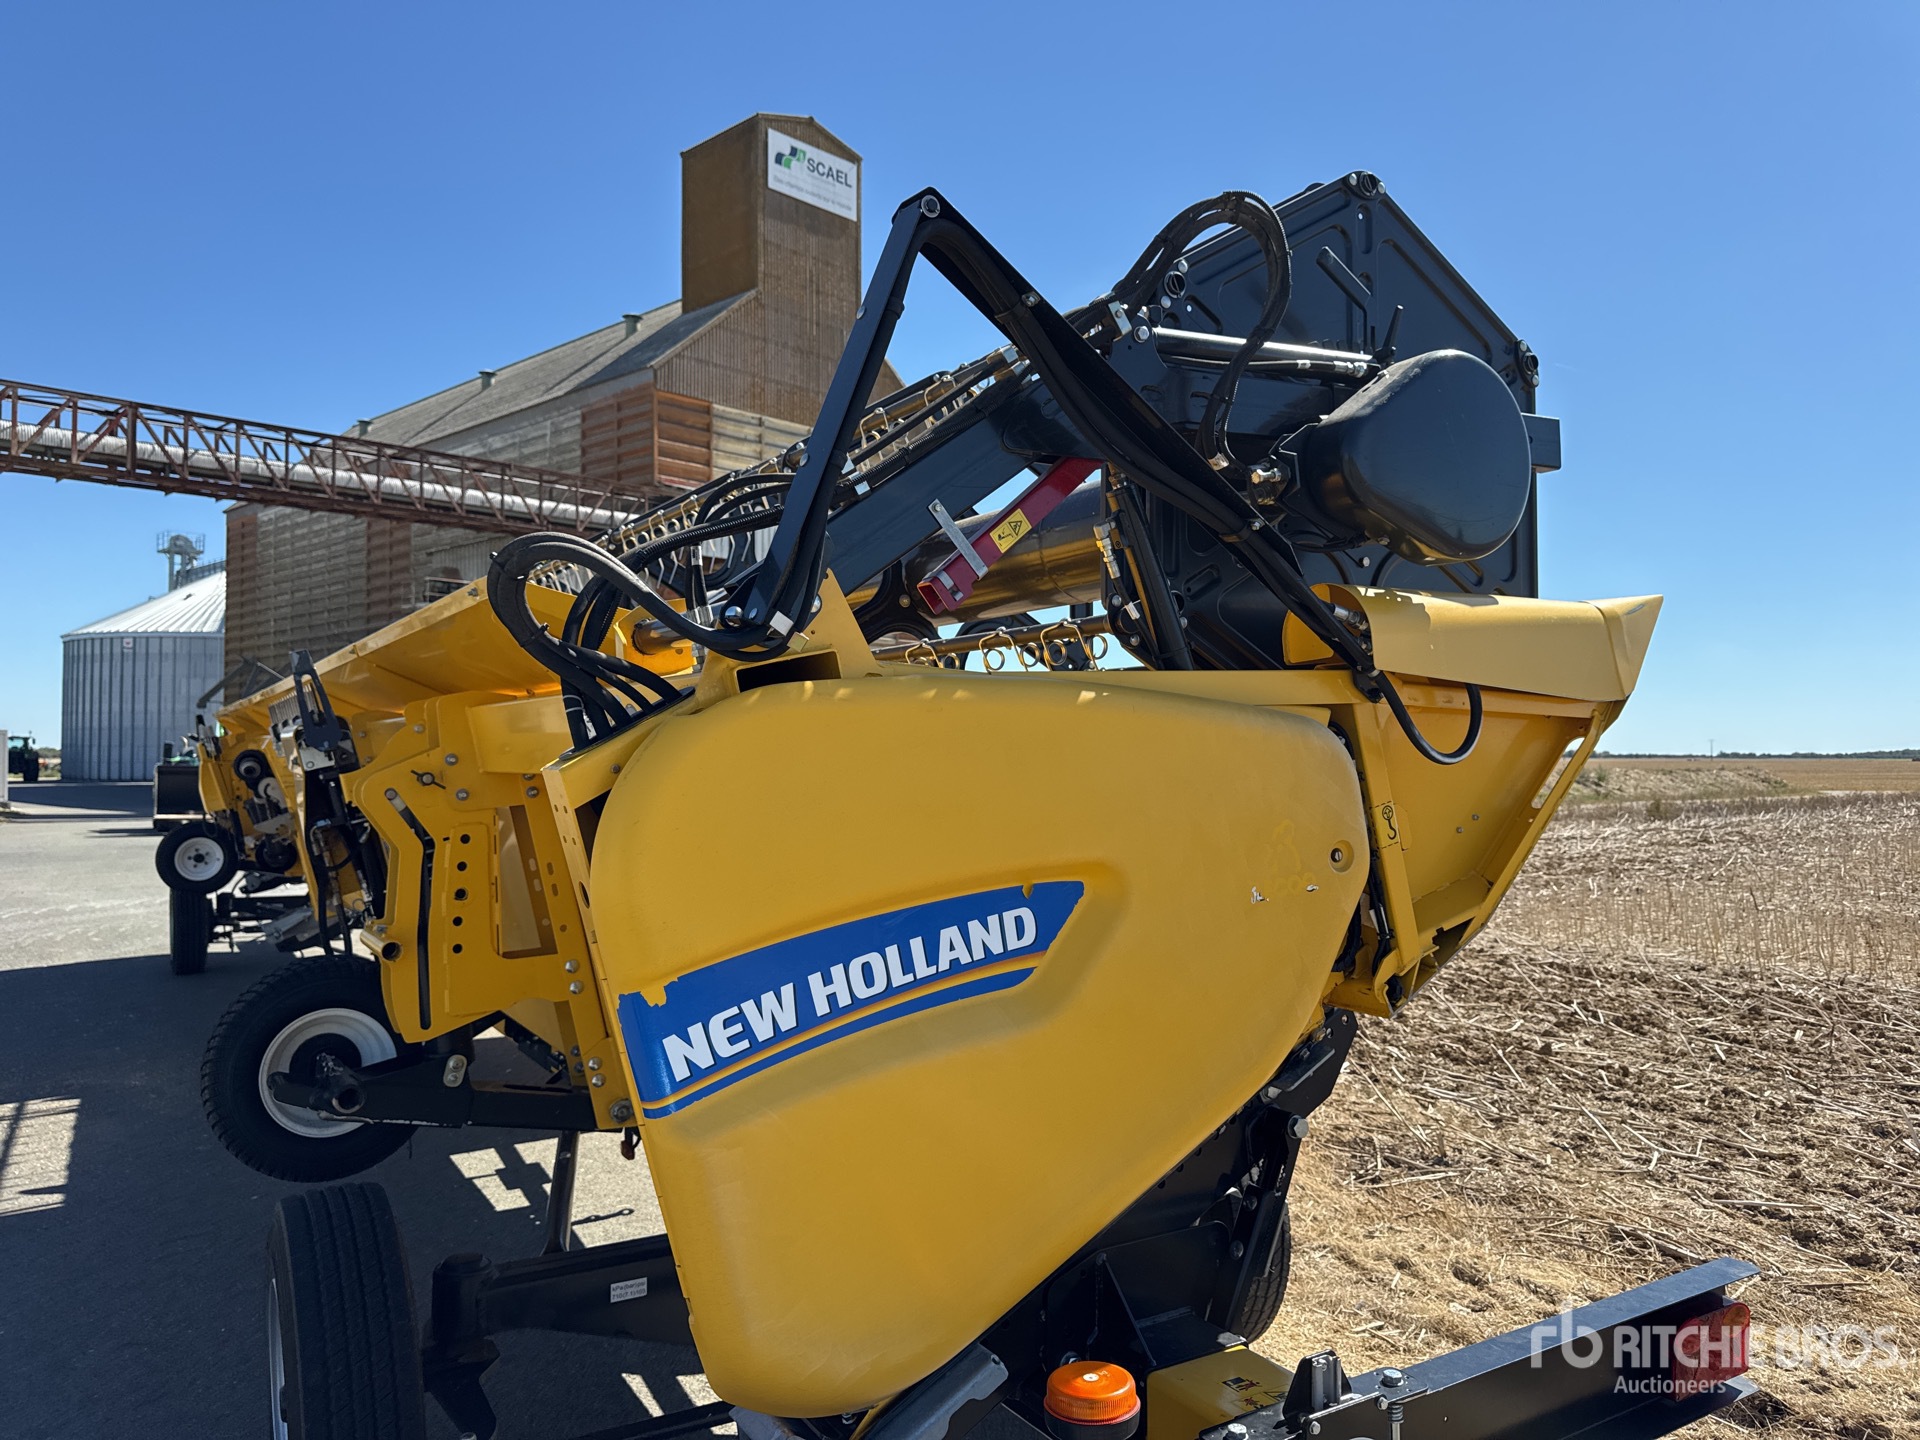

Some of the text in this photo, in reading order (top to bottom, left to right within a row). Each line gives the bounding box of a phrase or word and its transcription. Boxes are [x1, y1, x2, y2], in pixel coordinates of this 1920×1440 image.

[806, 157, 852, 188] SCAEL
[662, 906, 1037, 1083] NEW HOLLAND
